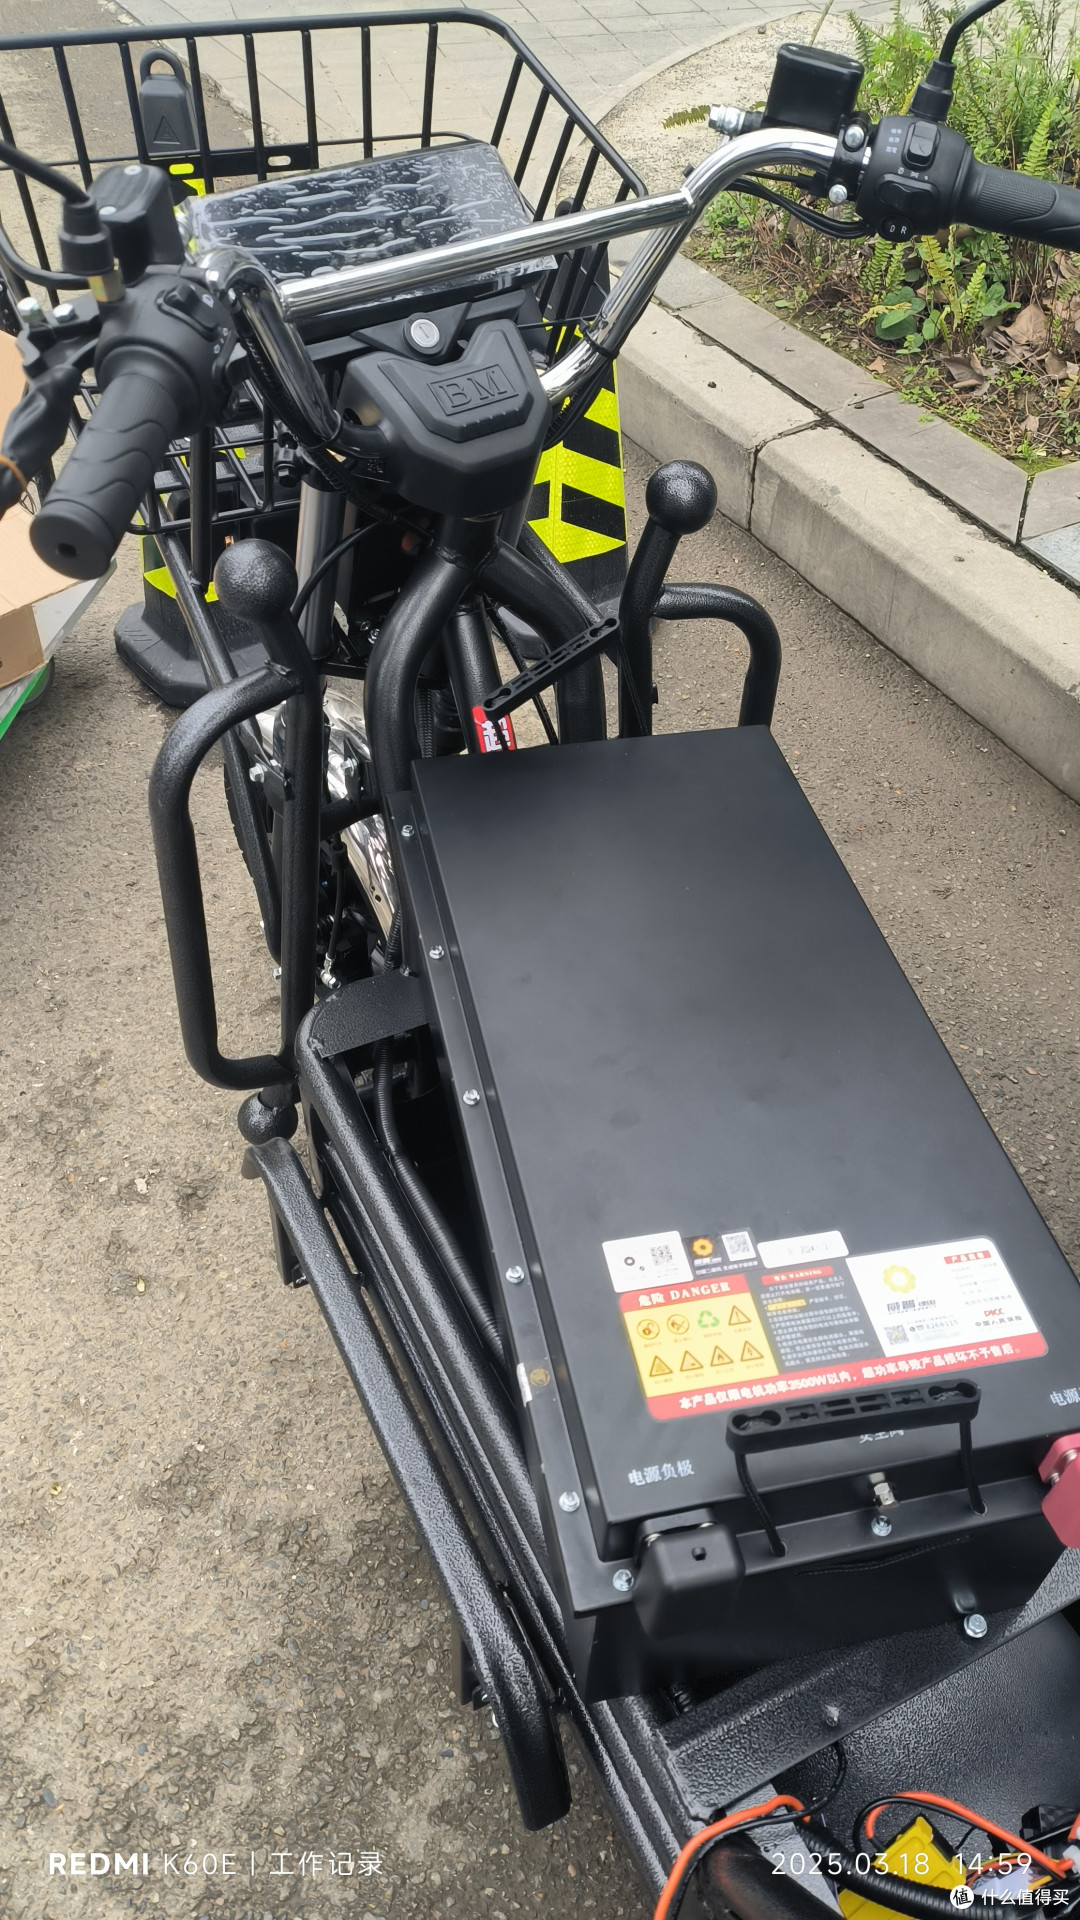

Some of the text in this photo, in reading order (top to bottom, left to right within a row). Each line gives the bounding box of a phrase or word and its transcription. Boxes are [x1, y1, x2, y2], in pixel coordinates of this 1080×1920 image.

[889, 224, 908, 235] D R
[439, 370, 508, 408] BM
[638, 1281, 731, 1307] 危险 DANGER
[1050, 1387, 1080, 1407] 电源
[627, 1459, 695, 1486] 电源负极
